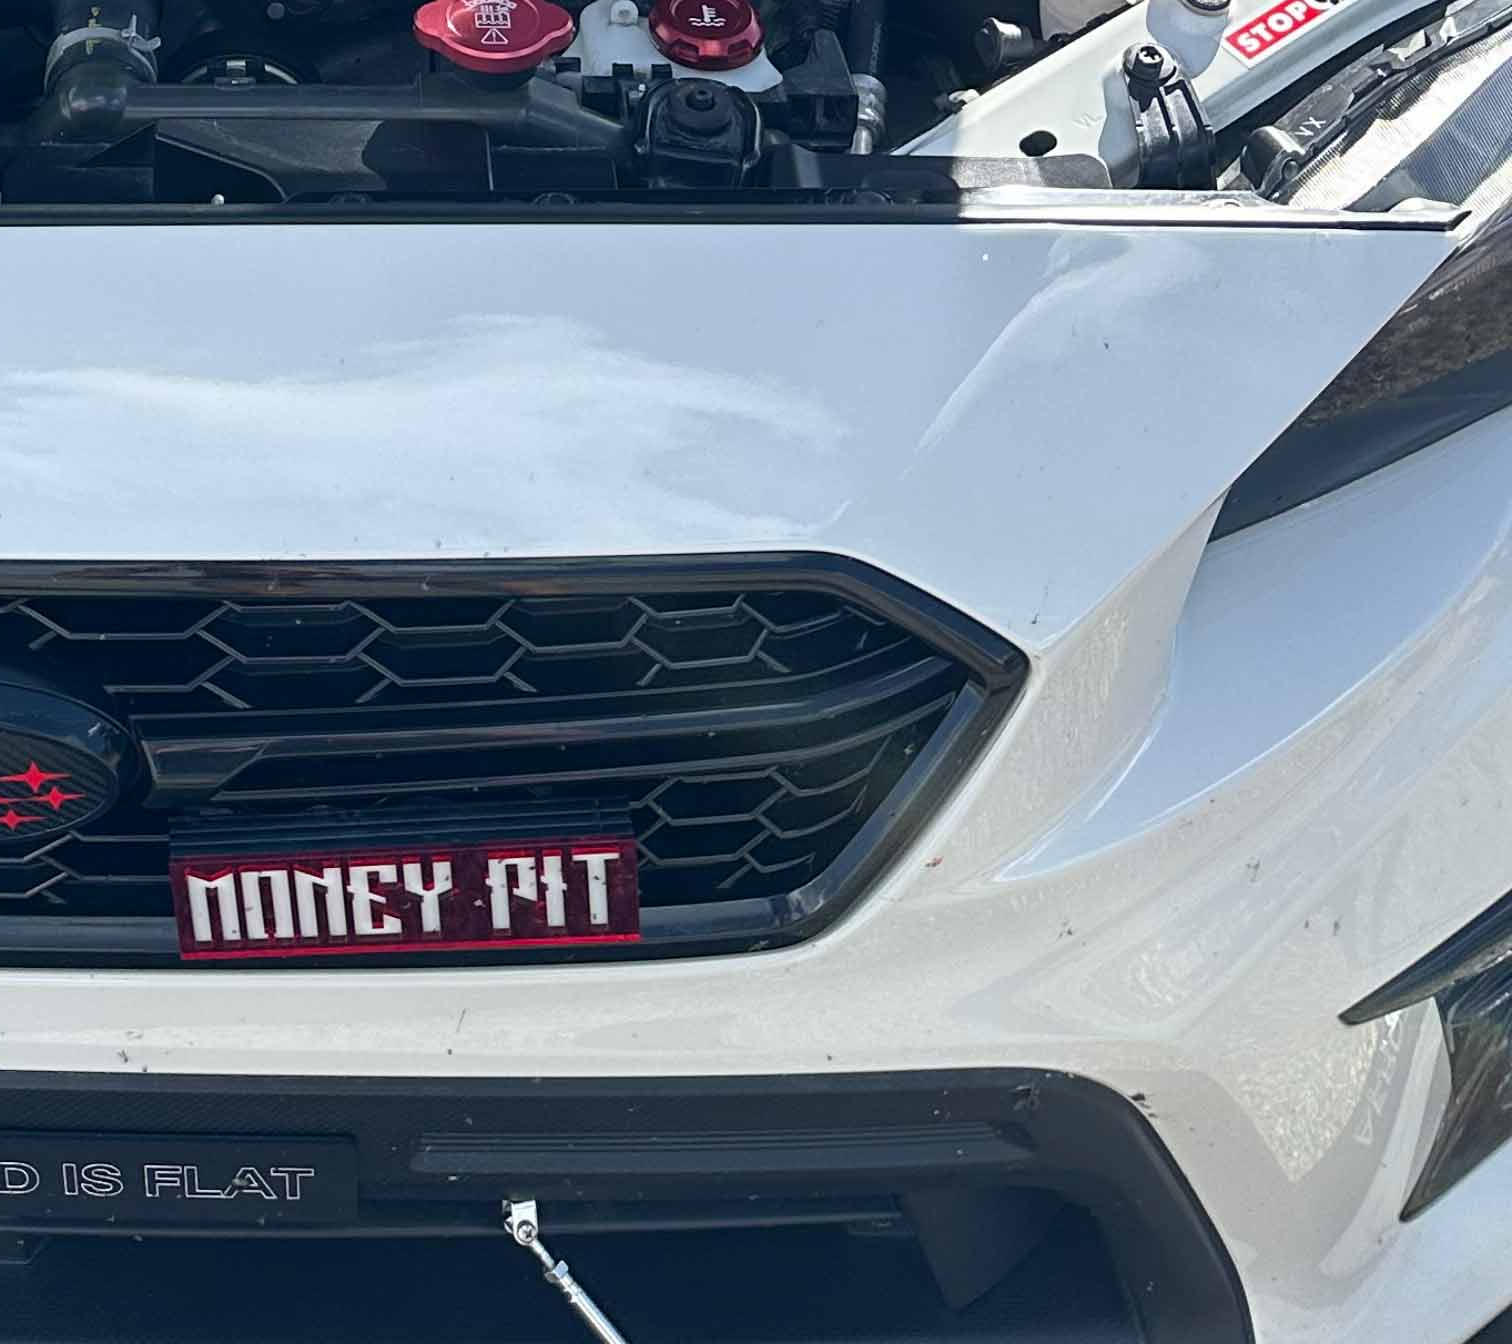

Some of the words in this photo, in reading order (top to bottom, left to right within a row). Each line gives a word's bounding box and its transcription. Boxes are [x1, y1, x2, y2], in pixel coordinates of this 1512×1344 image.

[185, 860, 454, 943] MONEY
[485, 850, 620, 930] PIT
[63, 1162, 124, 1198] IS
[143, 1164, 314, 1200] FLAT
